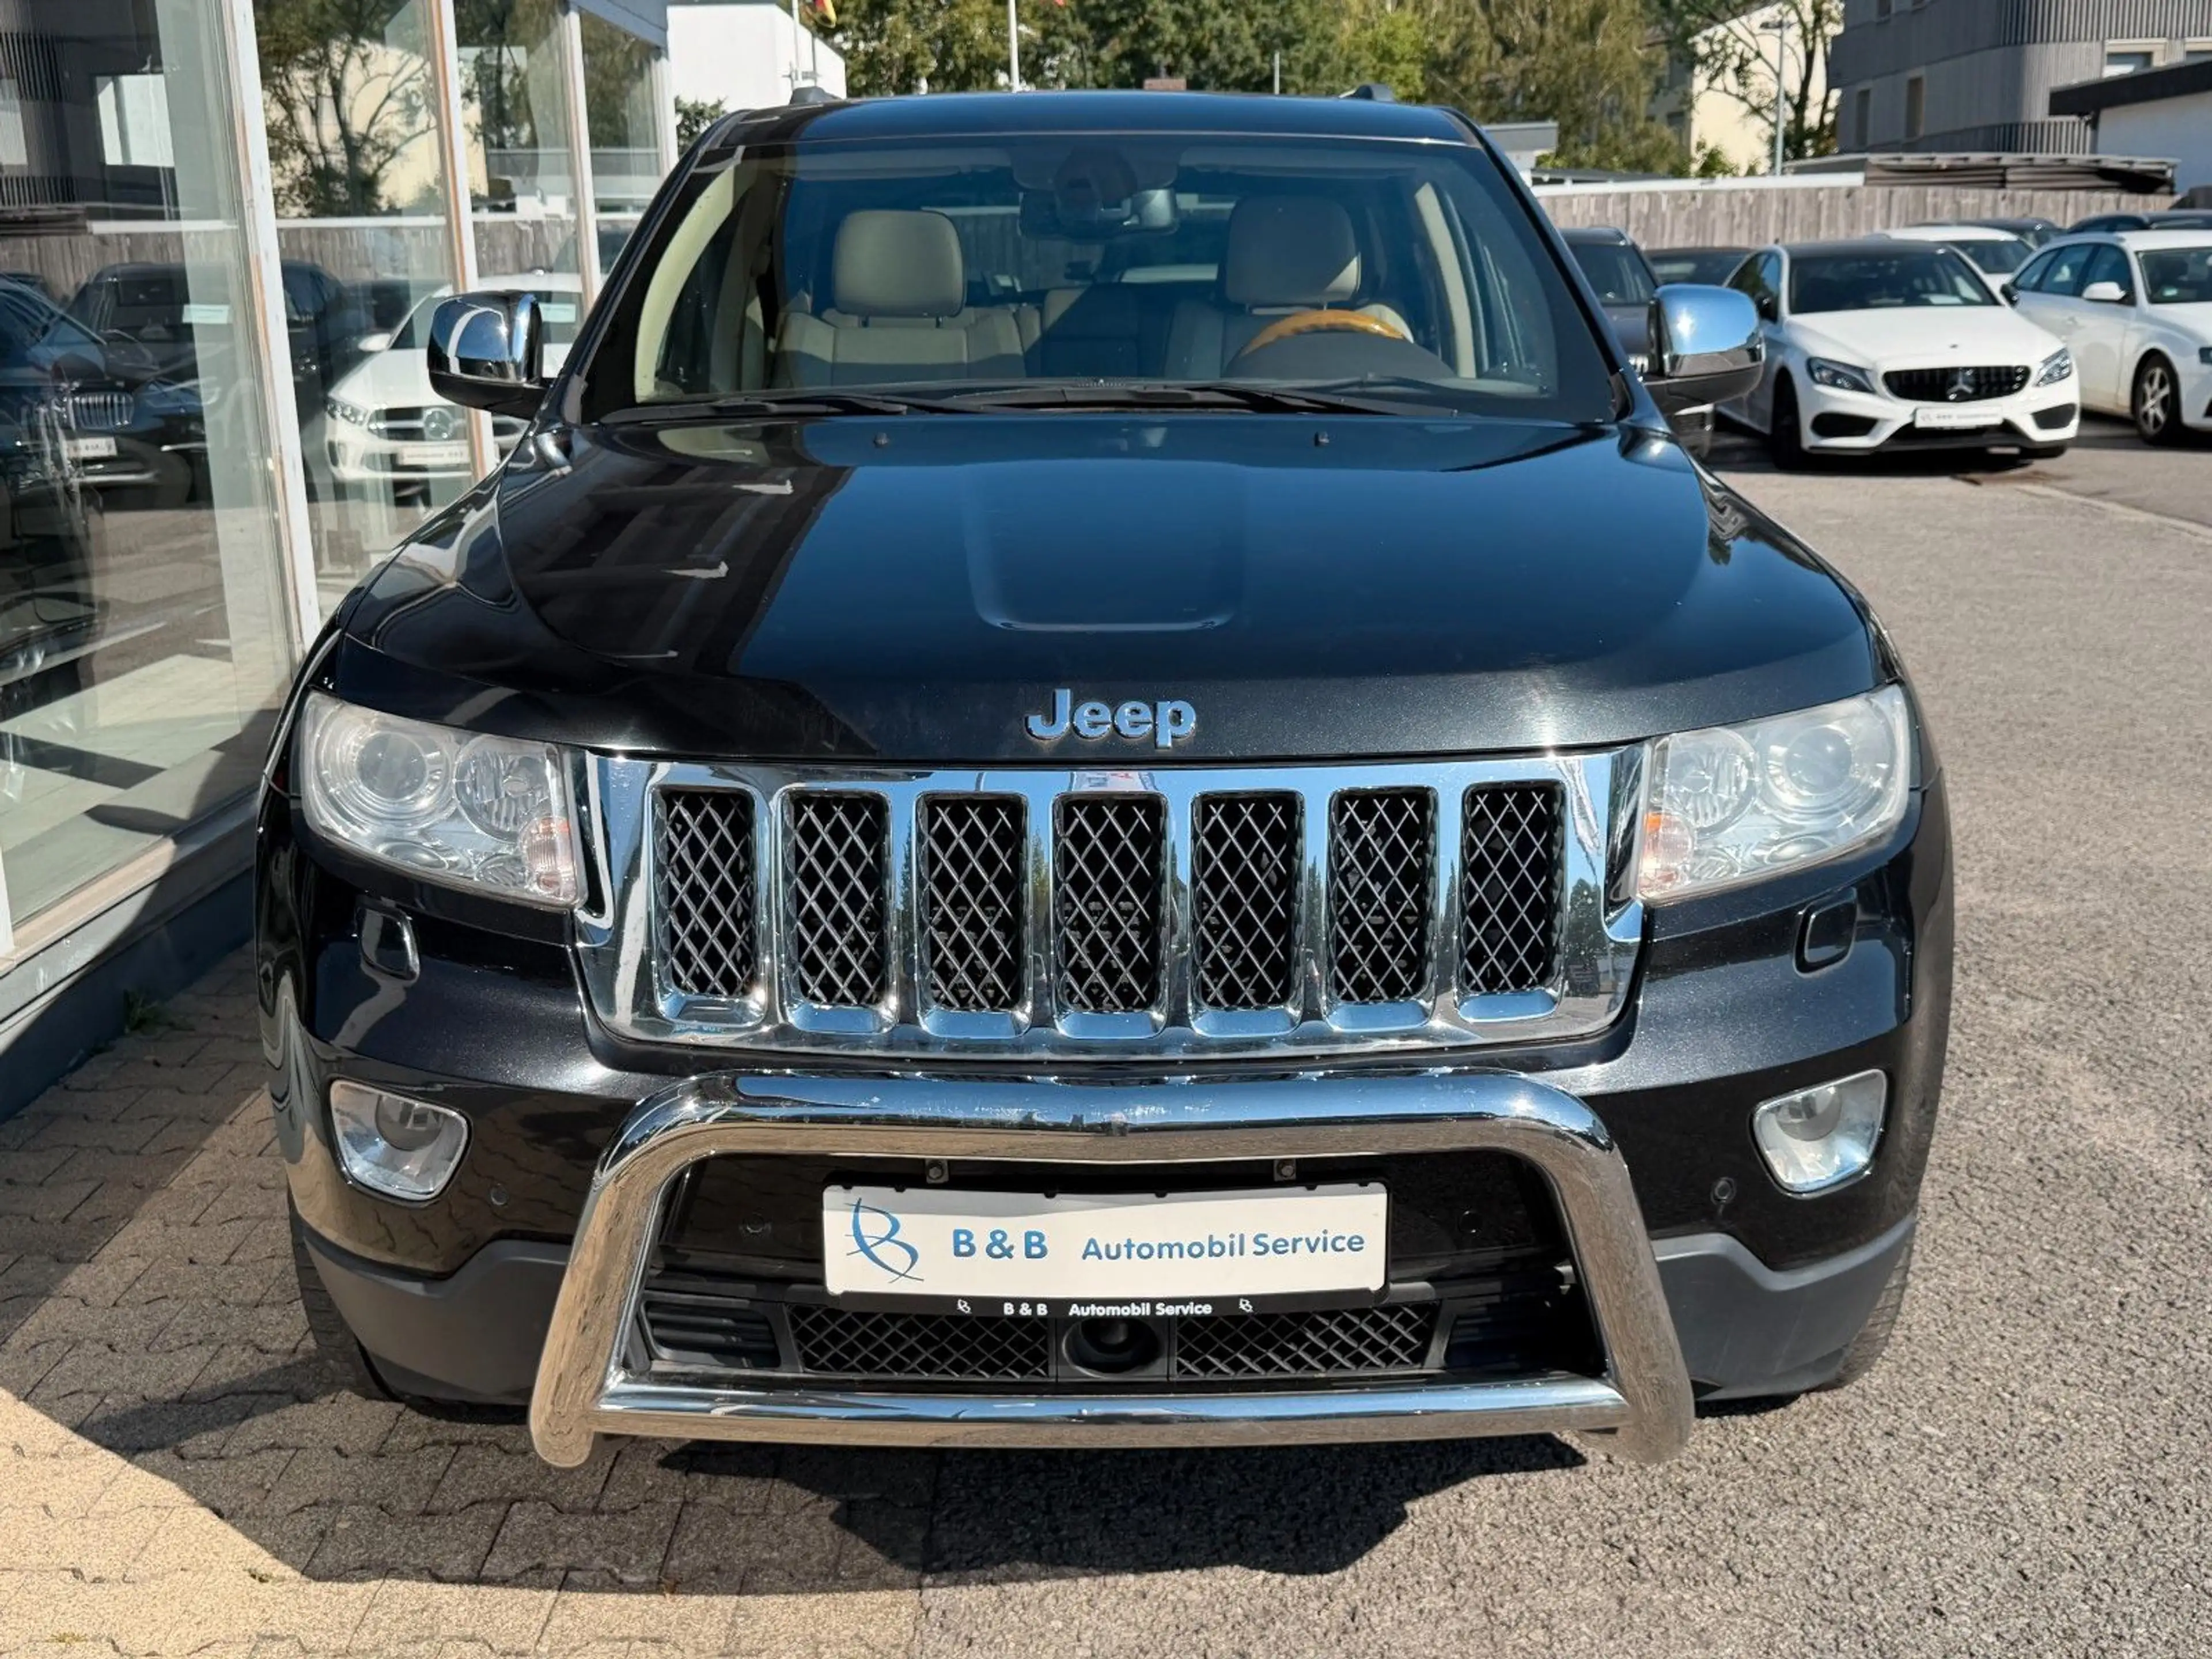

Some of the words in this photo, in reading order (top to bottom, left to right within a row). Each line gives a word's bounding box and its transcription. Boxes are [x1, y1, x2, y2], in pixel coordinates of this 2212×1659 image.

[1025, 688, 1197, 749] Jeep
[952, 1229, 976, 1259] B
[984, 1228, 1014, 1260] &
[1024, 1229, 1048, 1260] B
[1081, 1233, 1245, 1261] Automobil
[1252, 1229, 1365, 1257] Service
[1003, 1303, 1014, 1316] B
[1018, 1303, 1032, 1316] &
[1036, 1303, 1048, 1316] B
[1068, 1302, 1150, 1317] Automobil
[1155, 1302, 1213, 1316] Service
